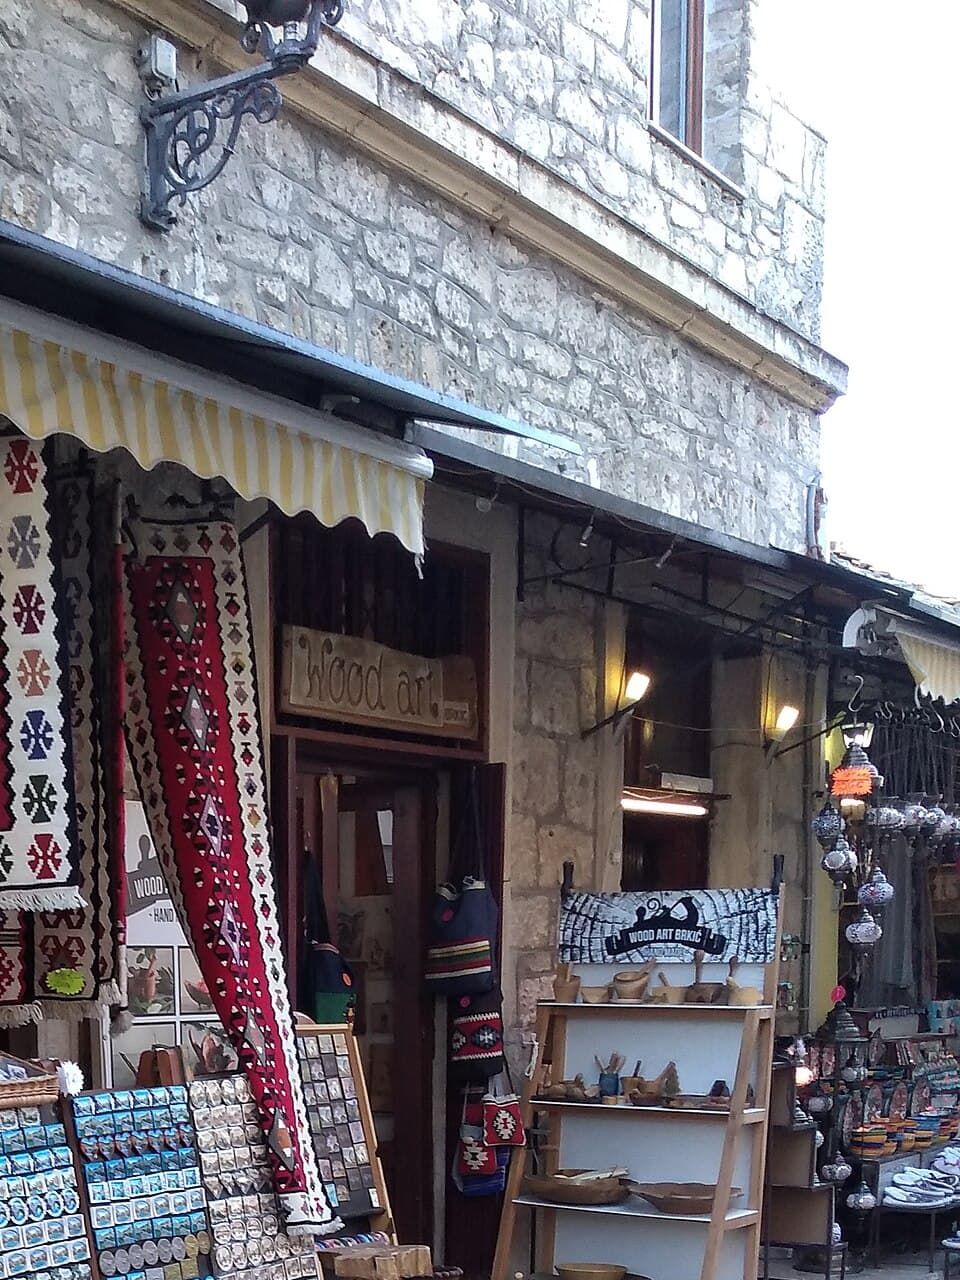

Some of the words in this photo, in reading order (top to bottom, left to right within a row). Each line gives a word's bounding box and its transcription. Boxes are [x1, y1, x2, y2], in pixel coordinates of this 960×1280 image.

[299, 634, 385, 710] Wood
[398, 665, 439, 718] art
[134, 876, 164, 898] WOOD
[628, 930, 655, 943] WOOD
[656, 928, 674, 940] ART
[675, 929, 702, 943] BRKIĆ
